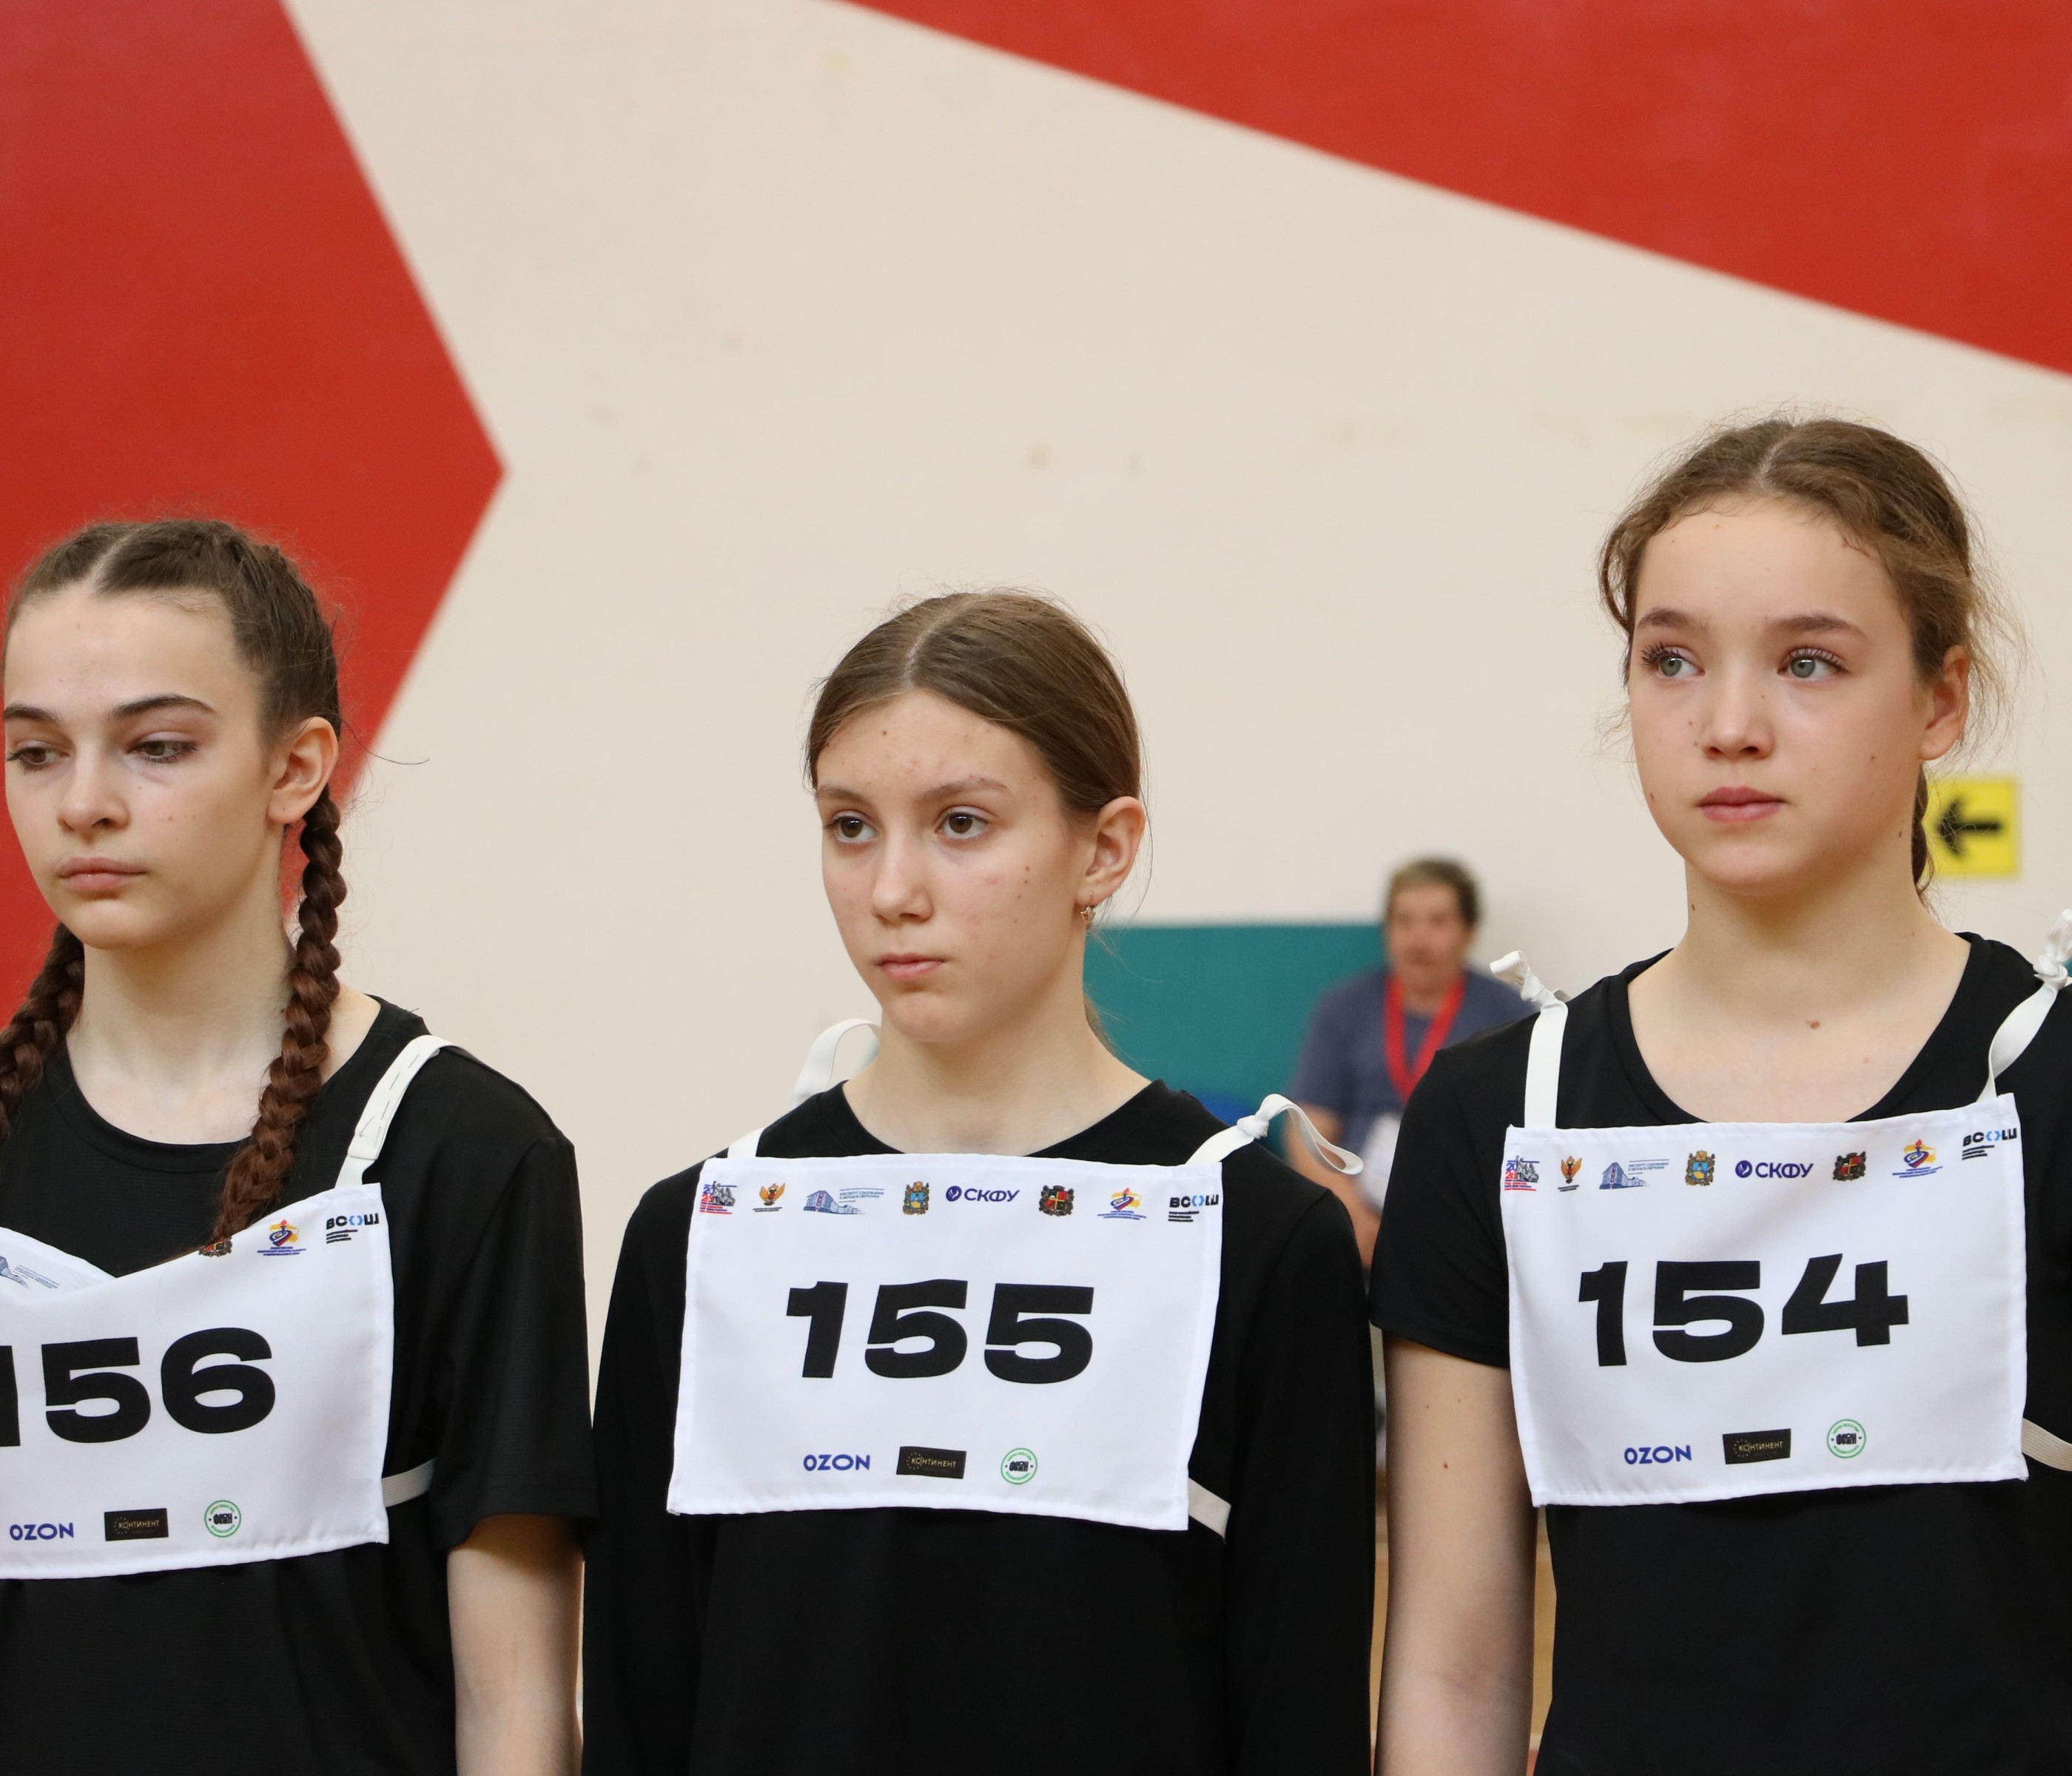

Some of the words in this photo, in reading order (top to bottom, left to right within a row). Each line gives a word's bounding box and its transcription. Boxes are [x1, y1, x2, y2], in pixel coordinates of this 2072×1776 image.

[1755, 1162, 1814, 1179] СКФУ
[963, 1188, 1020, 1202] СКФУ
[1578, 1253, 1909, 1367] 154
[786, 1279, 1094, 1385] 155
[1624, 1444, 1692, 1465] OZON
[1738, 1441, 1783, 1452] КОНТИНЕНТ
[803, 1453, 871, 1472] OZON
[911, 1457, 957, 1468] КОНТИНЕНТ
[9, 1522, 75, 1541] OZON
[118, 1519, 159, 1530] КОНТИНЕНТ
